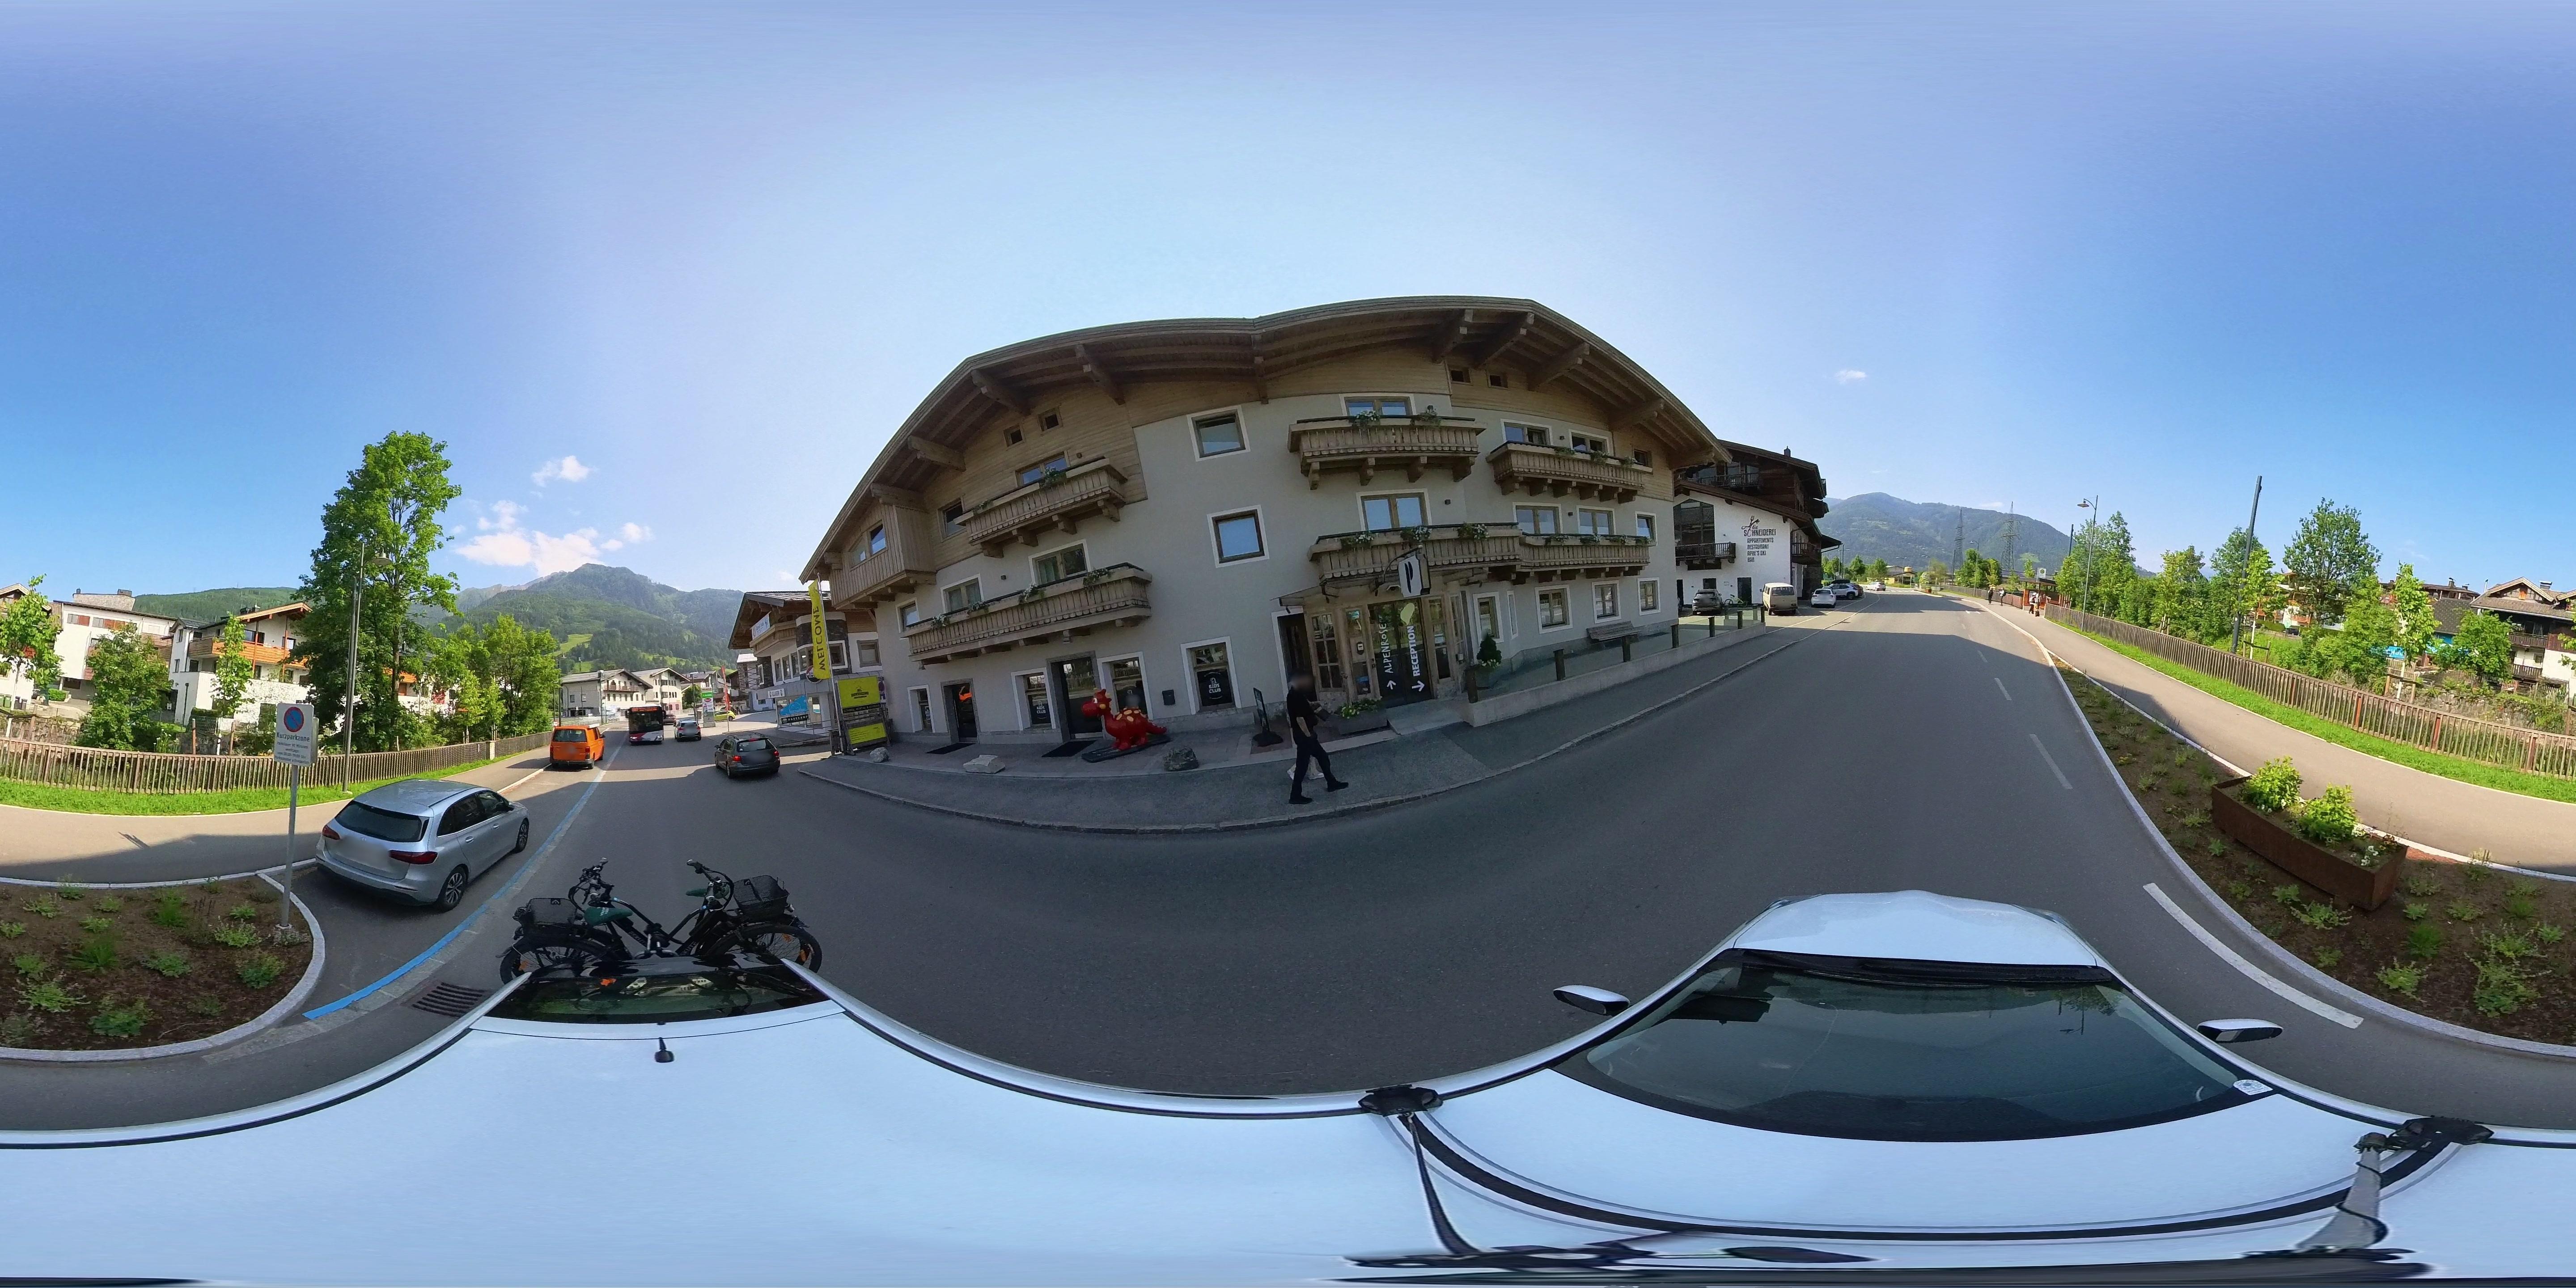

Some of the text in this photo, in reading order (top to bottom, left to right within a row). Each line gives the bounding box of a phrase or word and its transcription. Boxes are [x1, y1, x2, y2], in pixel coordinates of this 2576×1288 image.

[813, 606, 826, 670] WELCOME
[1379, 623, 1394, 673] ALPENROSE
[1407, 626, 1420, 677] RECEPTION
[277, 732, 310, 742] Kurzparkzone
